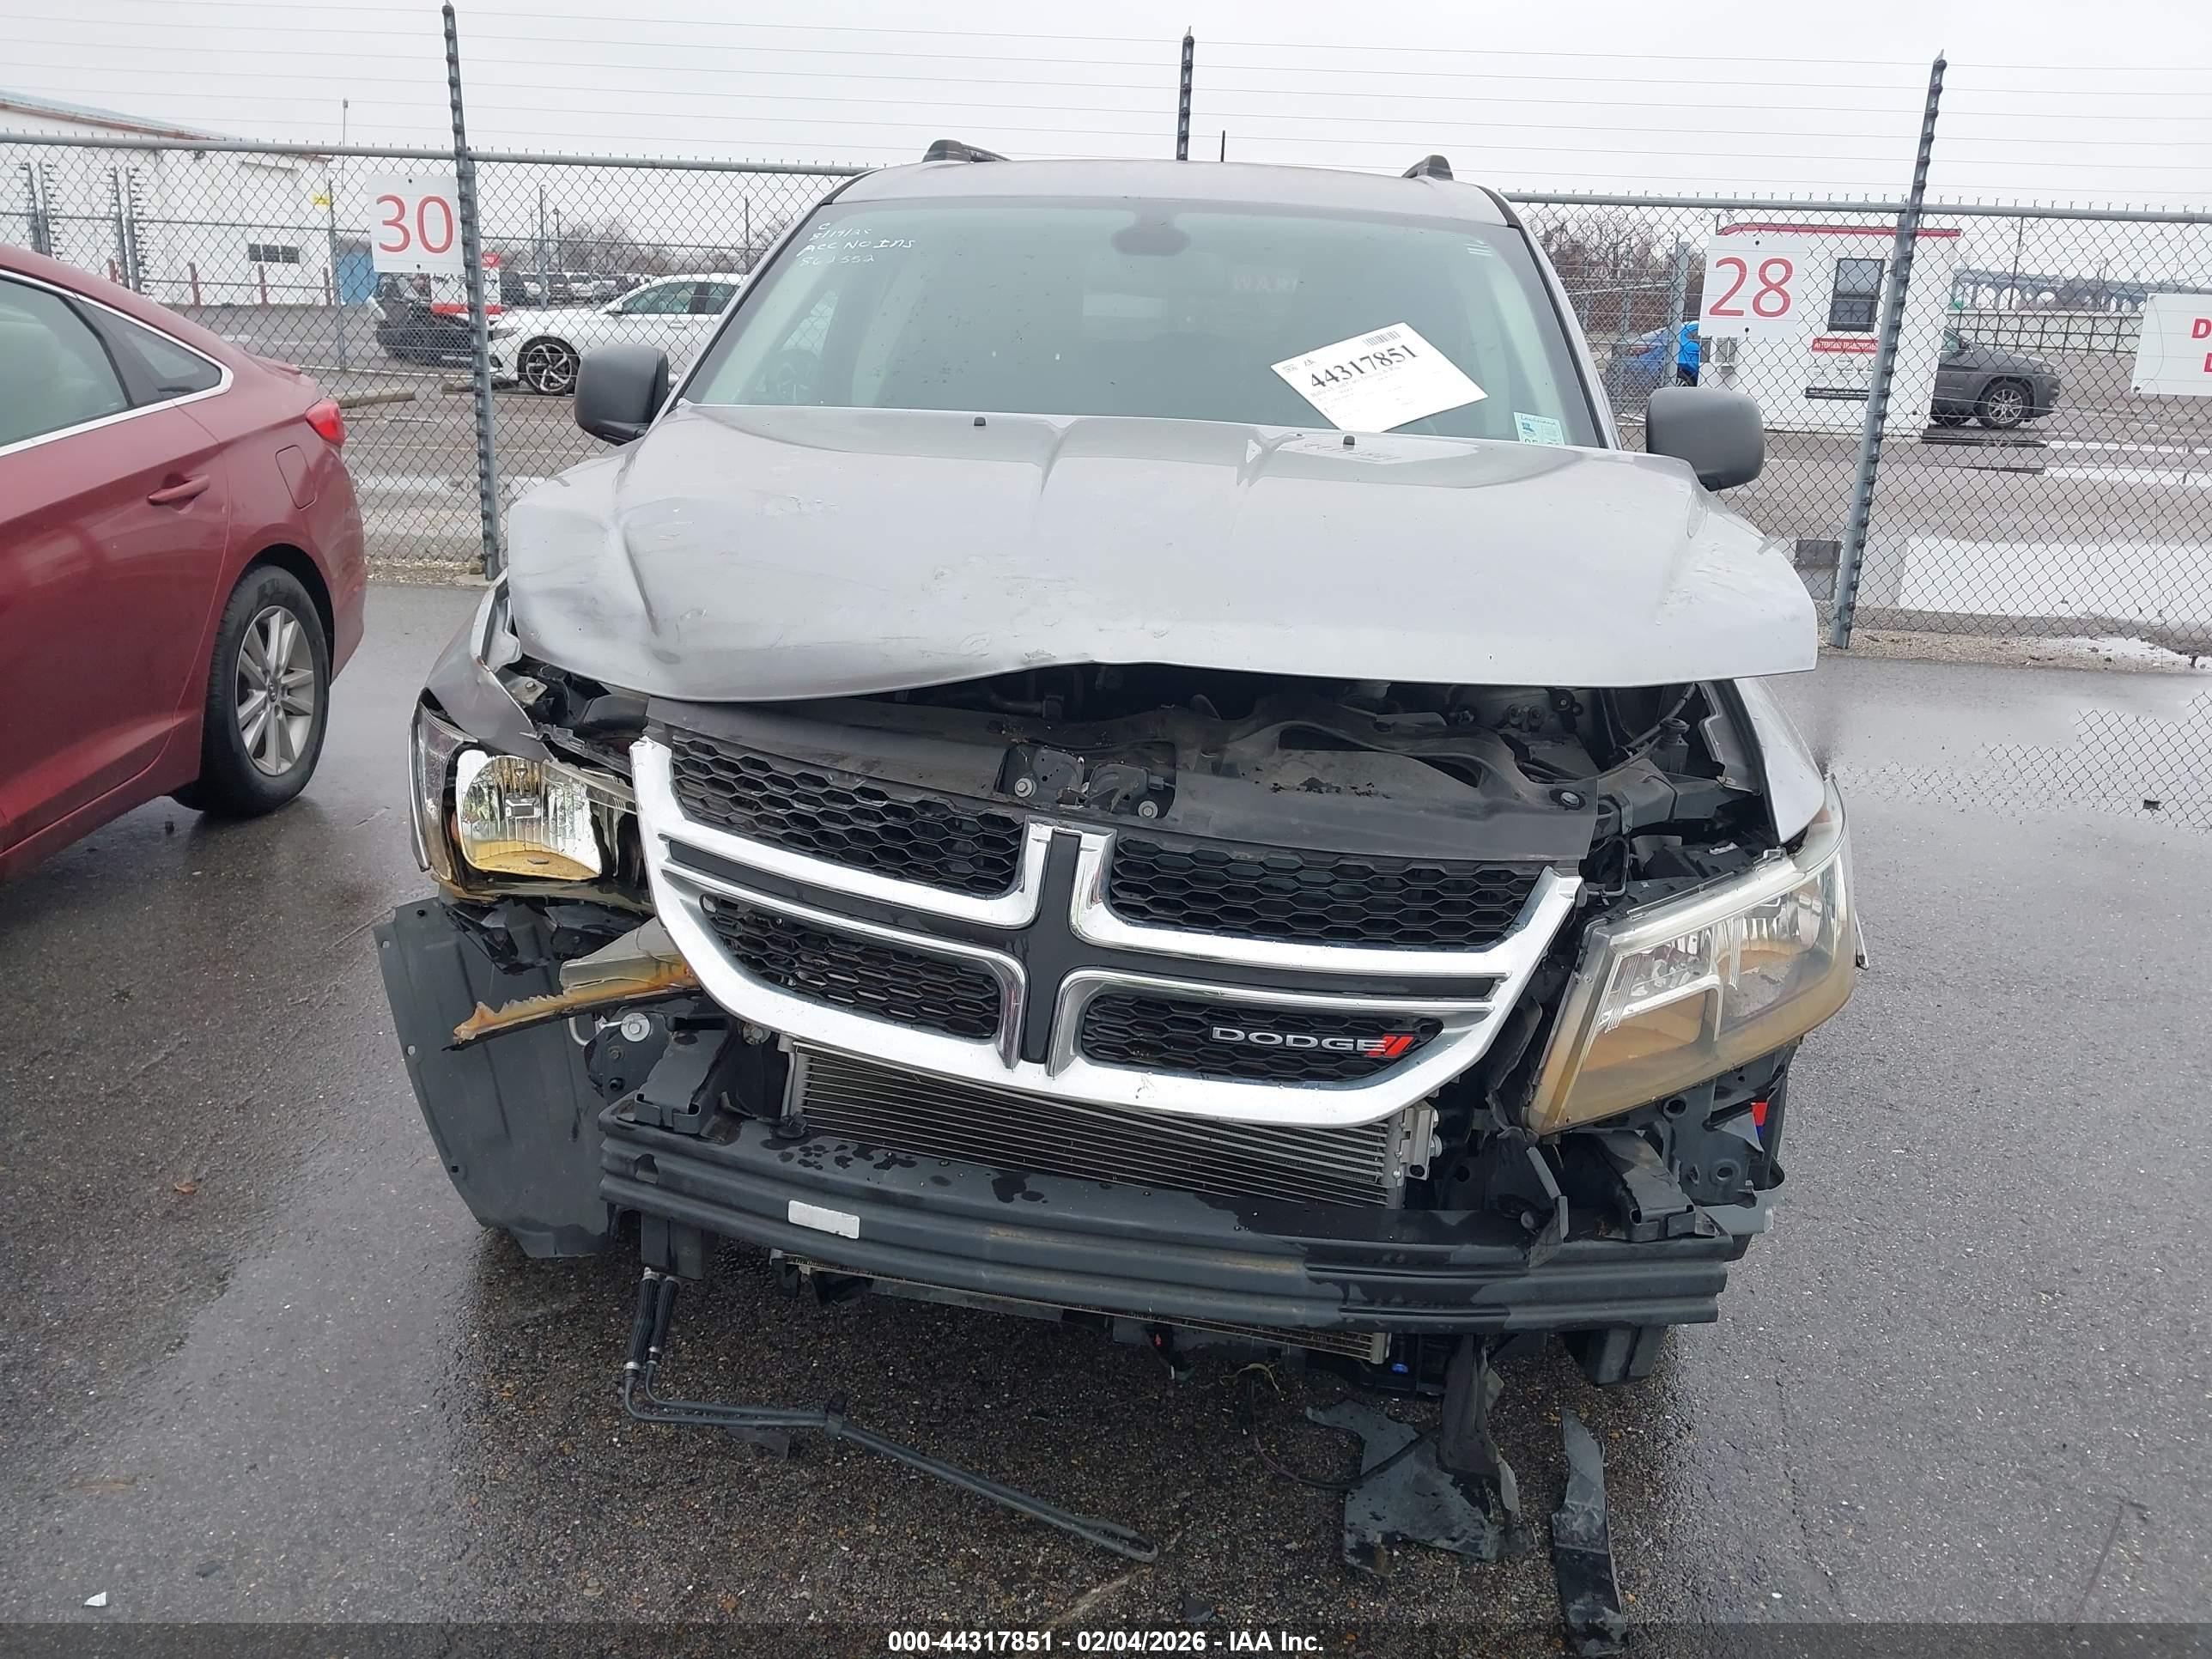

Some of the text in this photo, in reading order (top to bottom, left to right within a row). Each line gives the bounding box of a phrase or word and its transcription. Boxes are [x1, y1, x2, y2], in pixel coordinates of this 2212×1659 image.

[375, 194, 453, 253] 30
[843, 240, 872, 250] NO
[1709, 257, 1794, 318] 28
[1311, 344, 1419, 387] 44317851
[1212, 1026, 1387, 1052] DODGE
